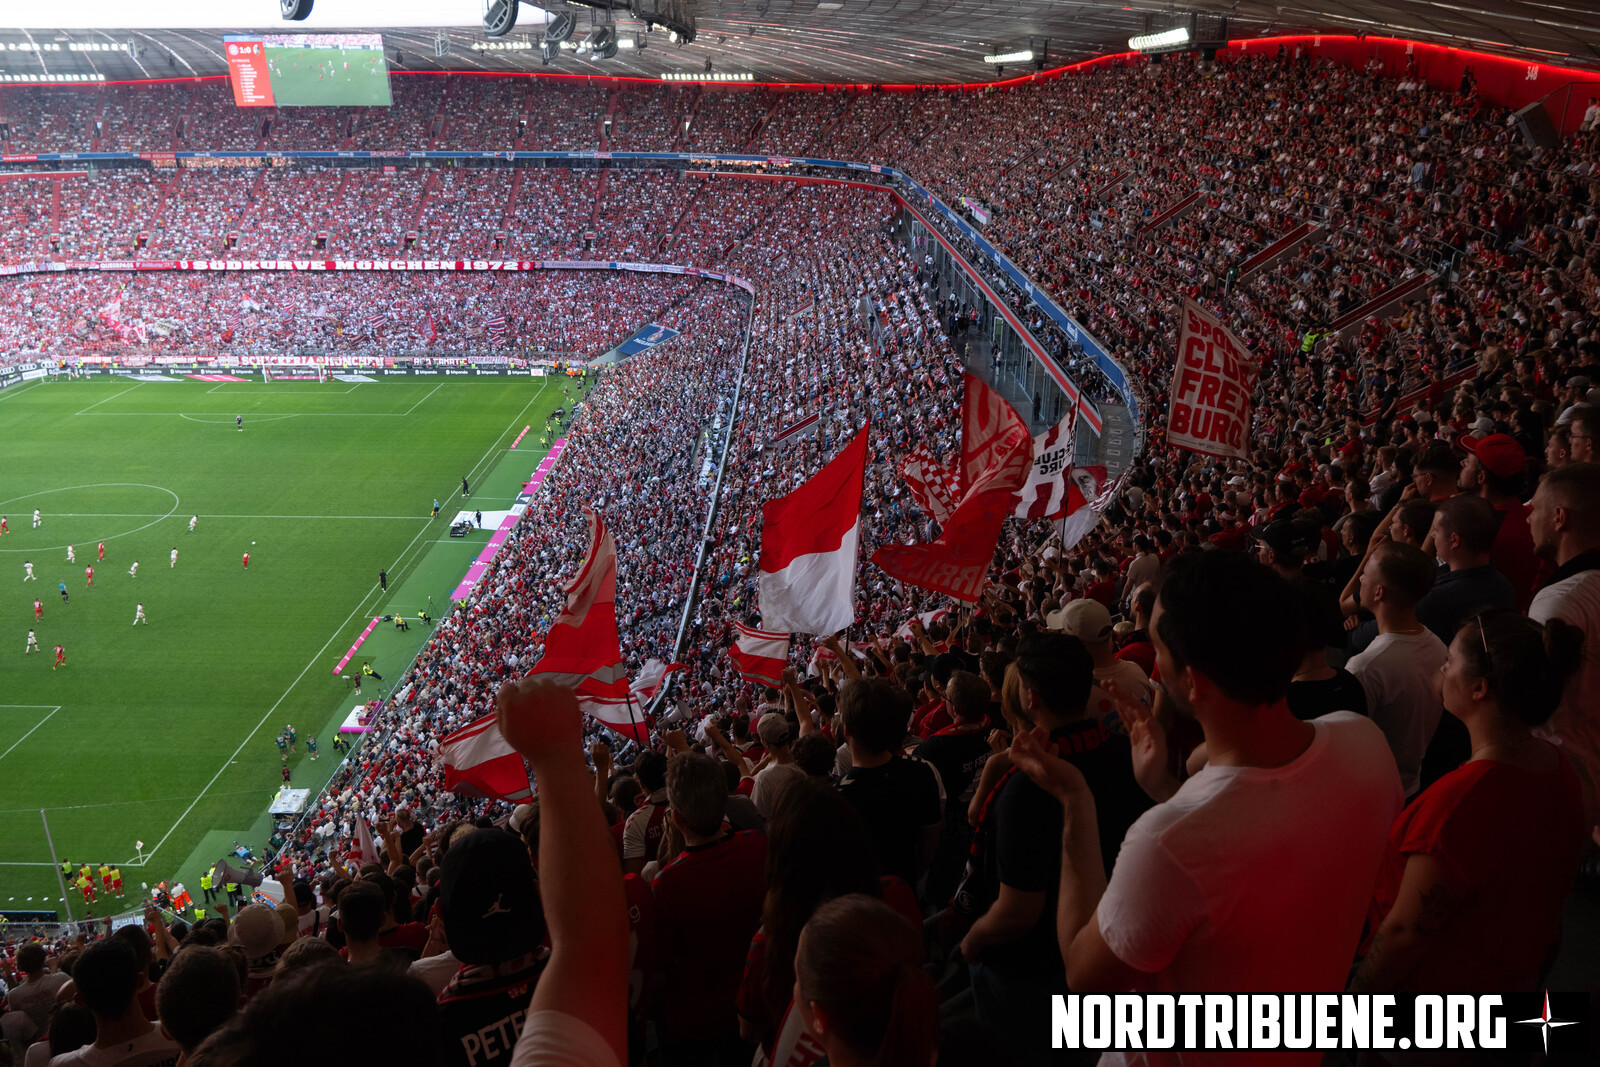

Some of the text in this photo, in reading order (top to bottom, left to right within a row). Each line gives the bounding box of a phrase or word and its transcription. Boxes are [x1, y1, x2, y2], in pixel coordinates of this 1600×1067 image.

[1525, 66, 1539, 81] 348
[193, 260, 519, 270] SÜDKURVE MÜNCHEN 1972
[1177, 368, 1250, 425] FREI
[1169, 402, 1243, 450] BURG
[460, 1008, 528, 1067] PETE
